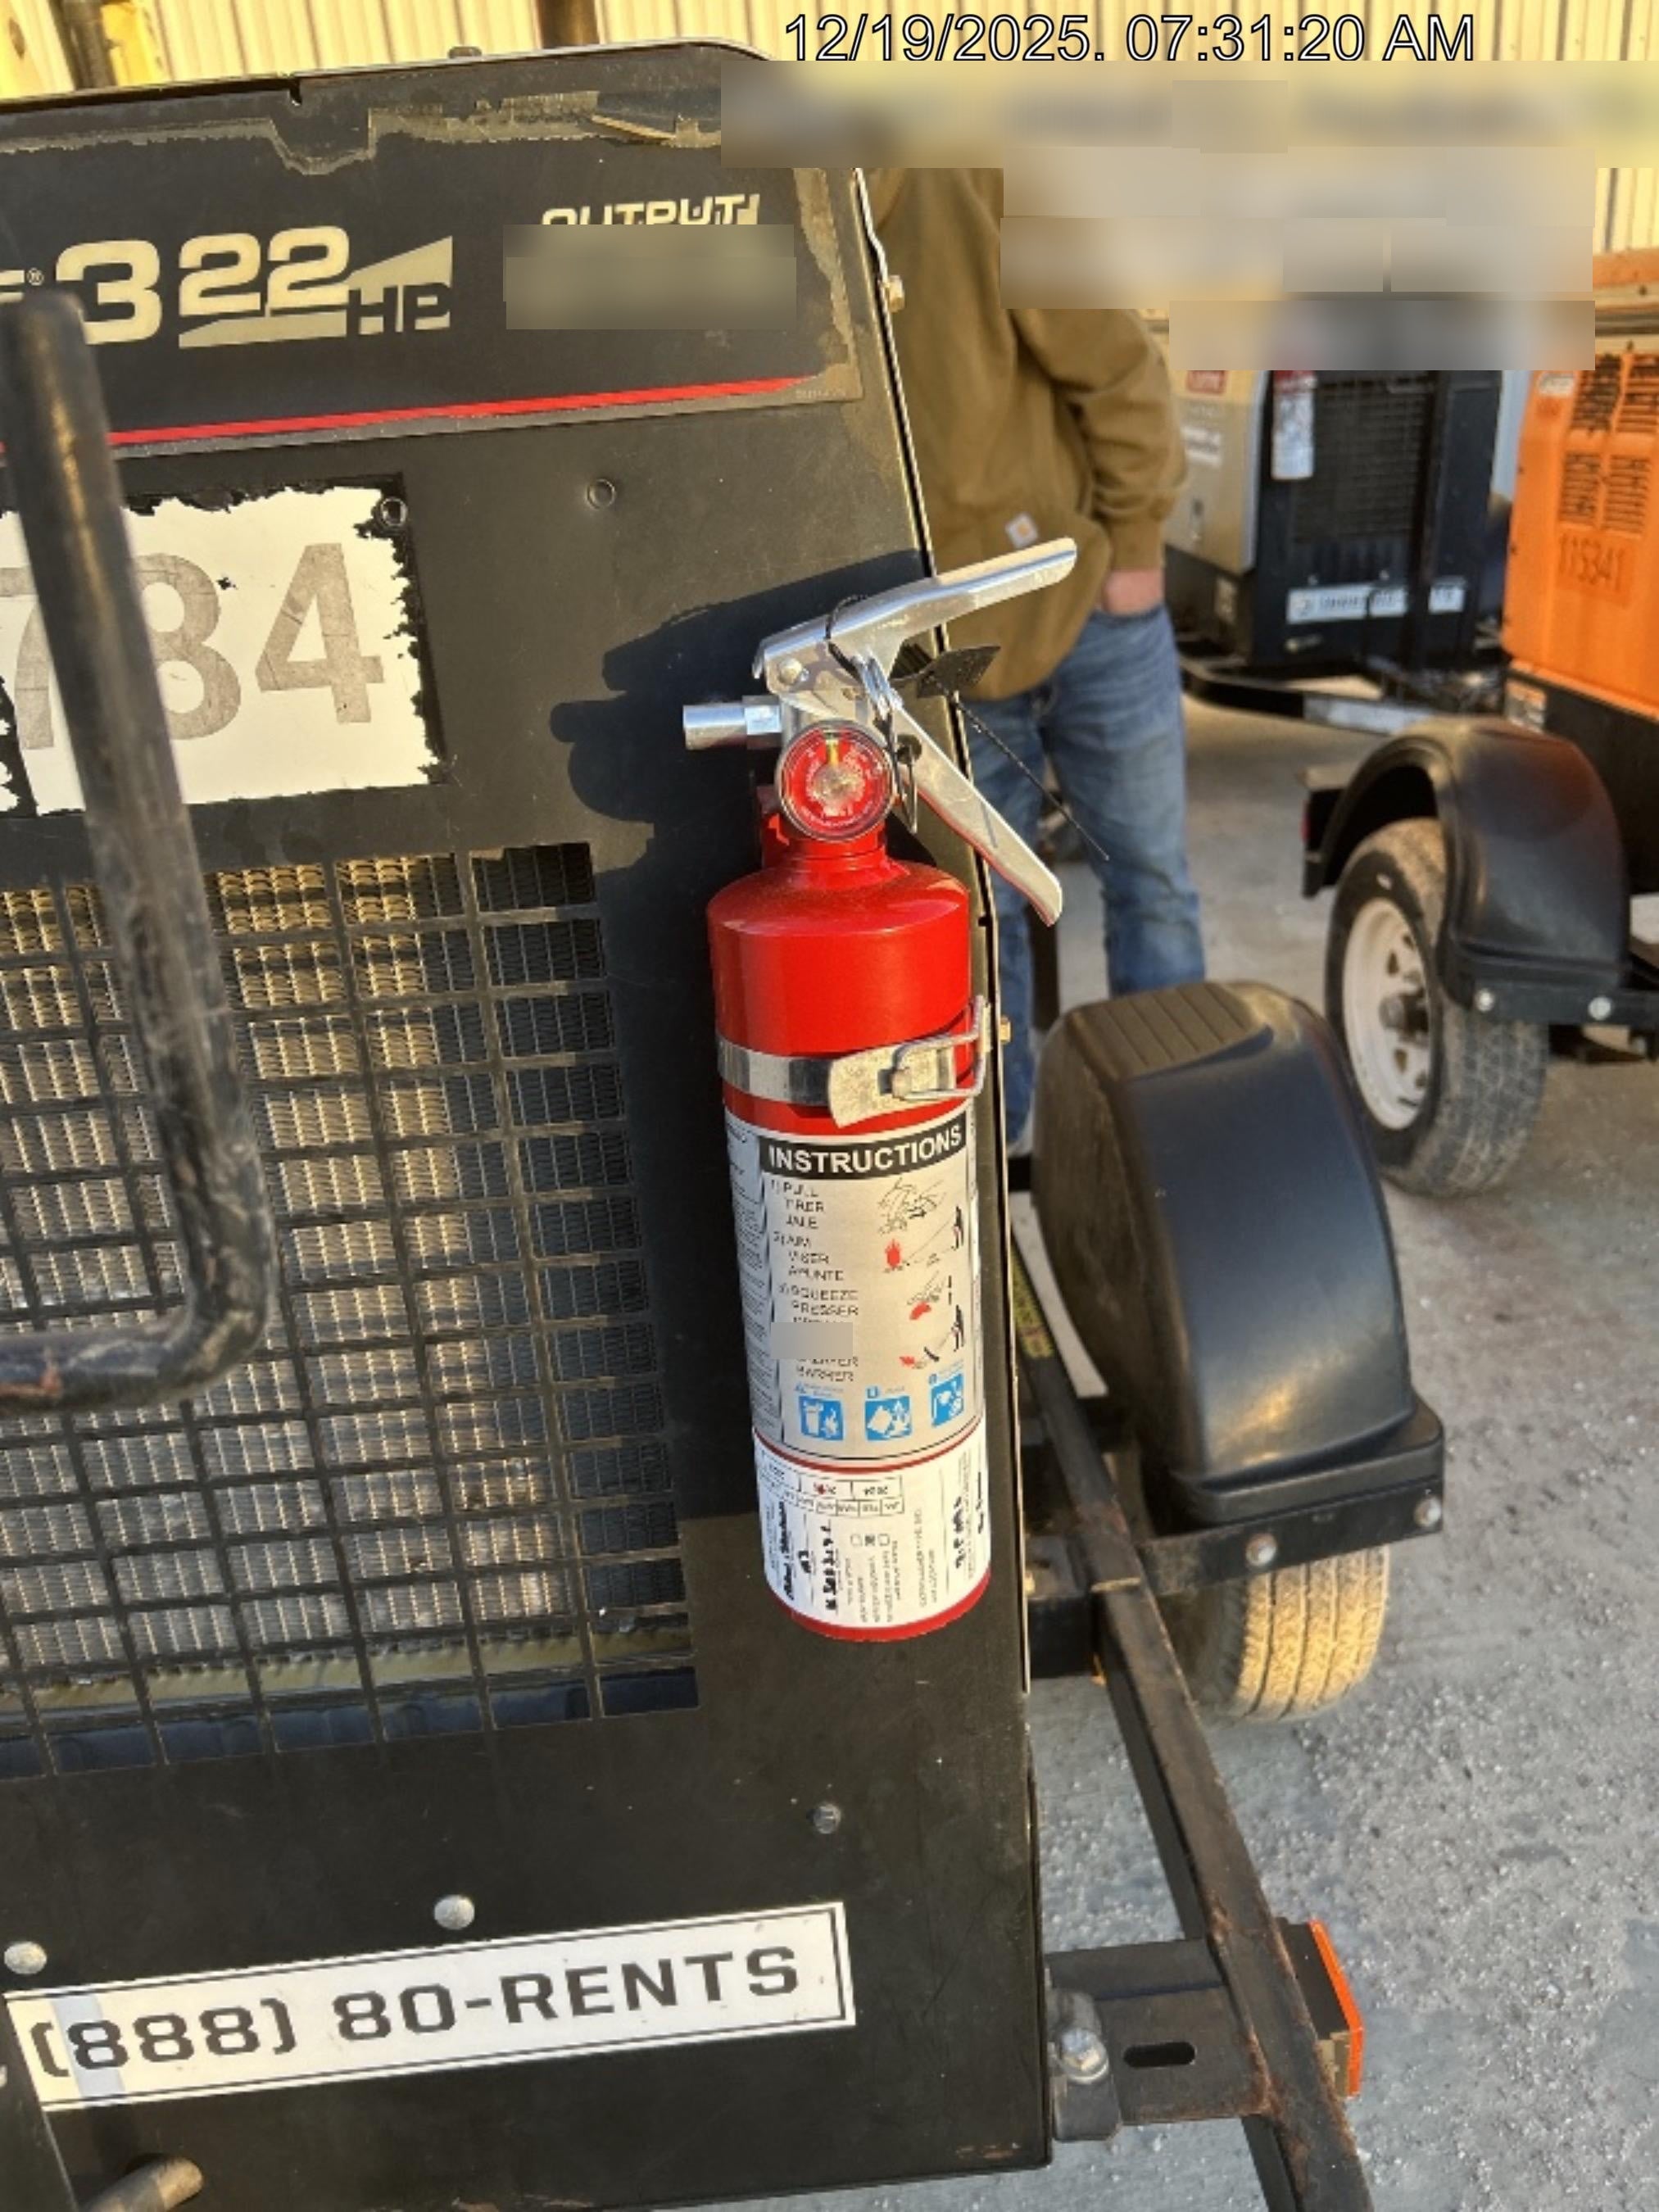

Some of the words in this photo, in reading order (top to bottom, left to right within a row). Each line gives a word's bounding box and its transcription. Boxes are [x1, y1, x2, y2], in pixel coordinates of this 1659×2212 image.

[768, 1125, 963, 1174] INSTRUCTIONS
[30, 1997, 297, 2078] (888)
[333, 1947, 799, 2041] 80-RENTS
